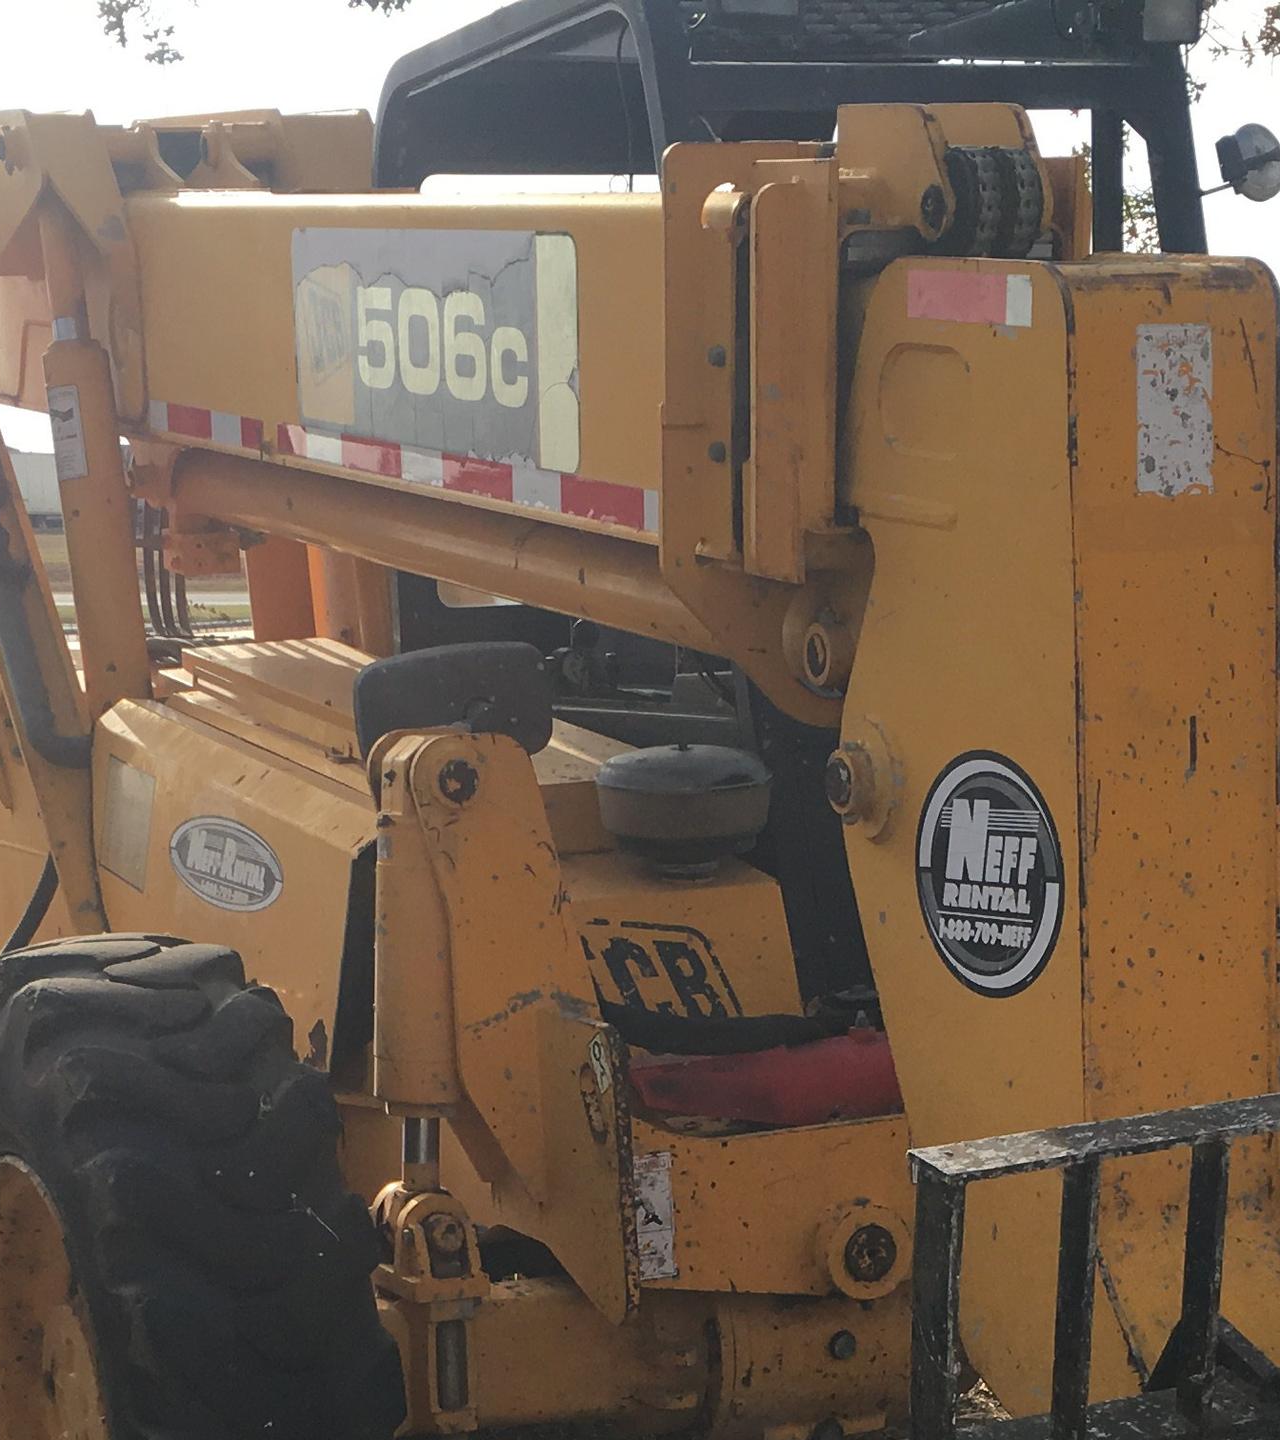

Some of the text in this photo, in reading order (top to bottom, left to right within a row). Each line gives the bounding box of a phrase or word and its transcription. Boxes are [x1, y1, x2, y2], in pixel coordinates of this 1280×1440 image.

[356, 286, 529, 409] 506c
[945, 797, 1039, 886] NEFF
[942, 882, 1032, 915] RENTAL
[581, 935, 728, 1018] CB
